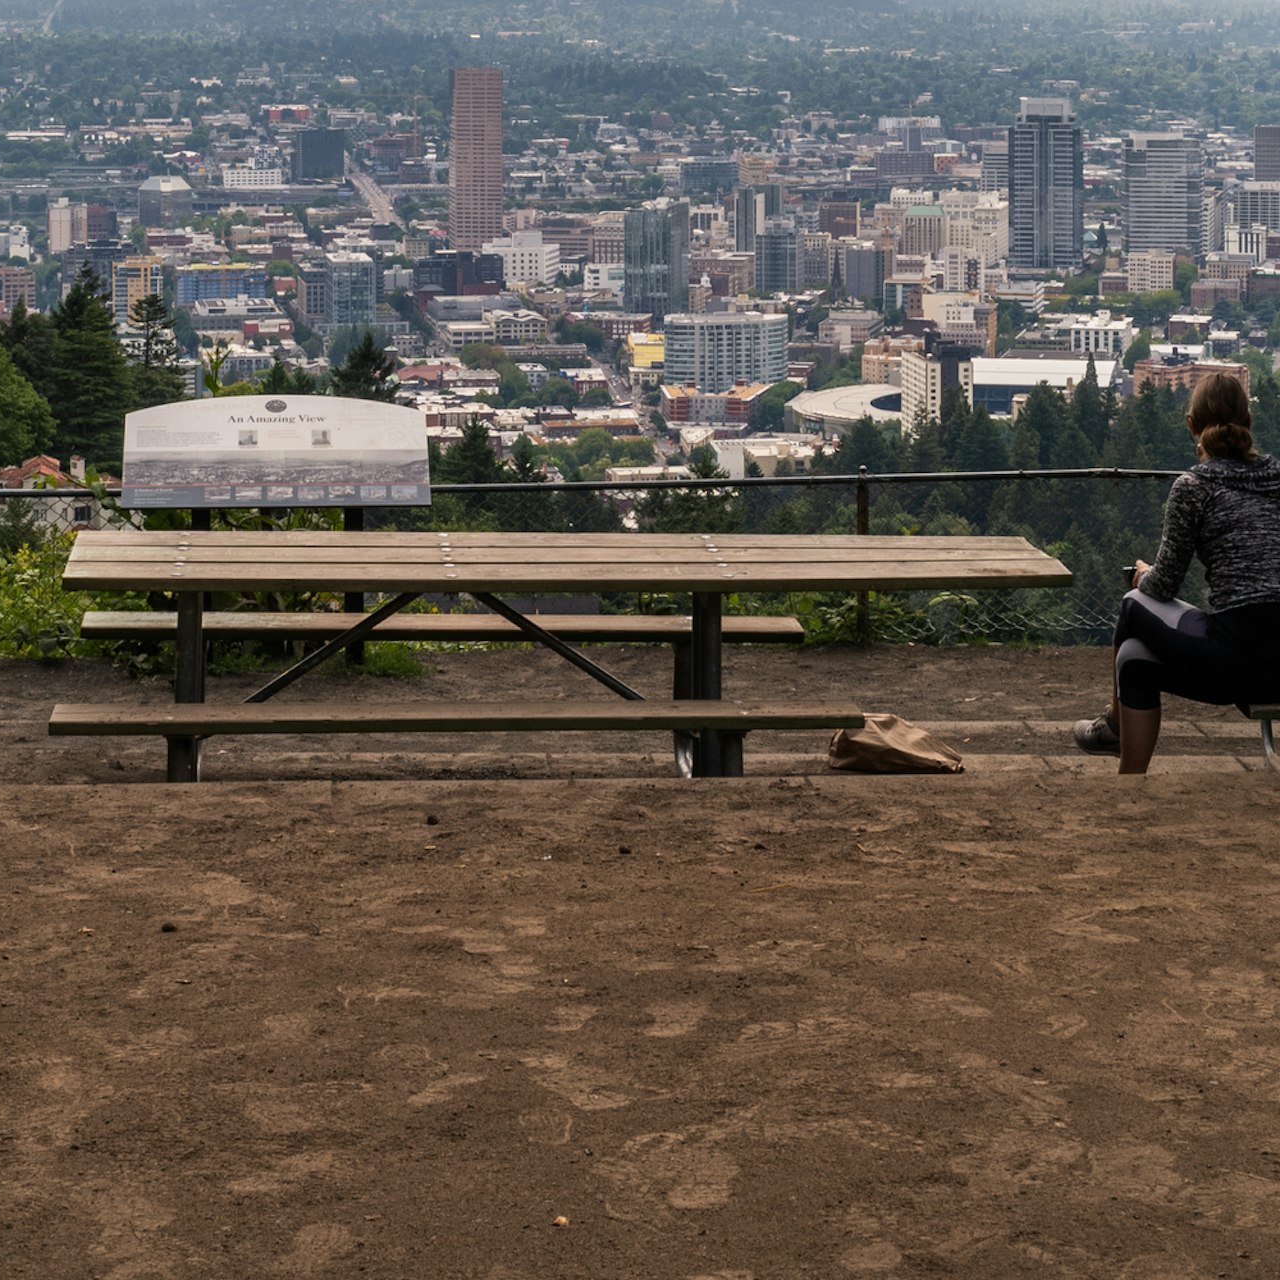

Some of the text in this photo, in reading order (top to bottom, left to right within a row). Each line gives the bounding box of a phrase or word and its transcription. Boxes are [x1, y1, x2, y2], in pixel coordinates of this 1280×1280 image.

[228, 414, 326, 424] An Amazing View
